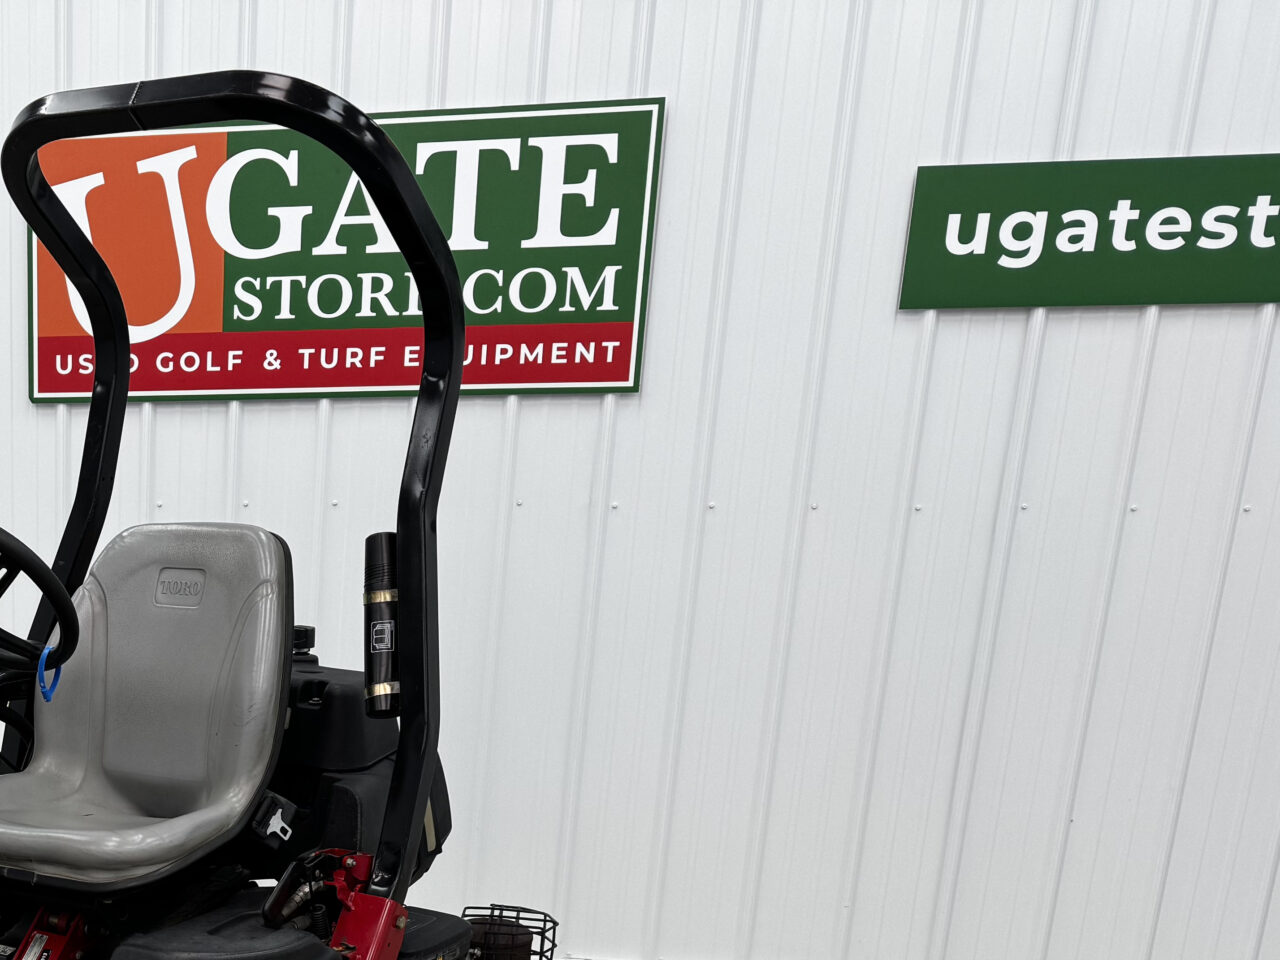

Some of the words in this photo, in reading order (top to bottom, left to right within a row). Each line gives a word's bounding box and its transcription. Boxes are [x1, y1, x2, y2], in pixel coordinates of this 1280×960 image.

[945, 195, 1280, 269] ugatest
[233, 265, 623, 321] STORCOM
[55, 353, 139, 375] US
[155, 350, 243, 373] GOLF
[262, 349, 281, 371] &
[298, 346, 386, 370] TURF
[403, 341, 621, 367] EIPMENT
[160, 580, 202, 596] TORO
